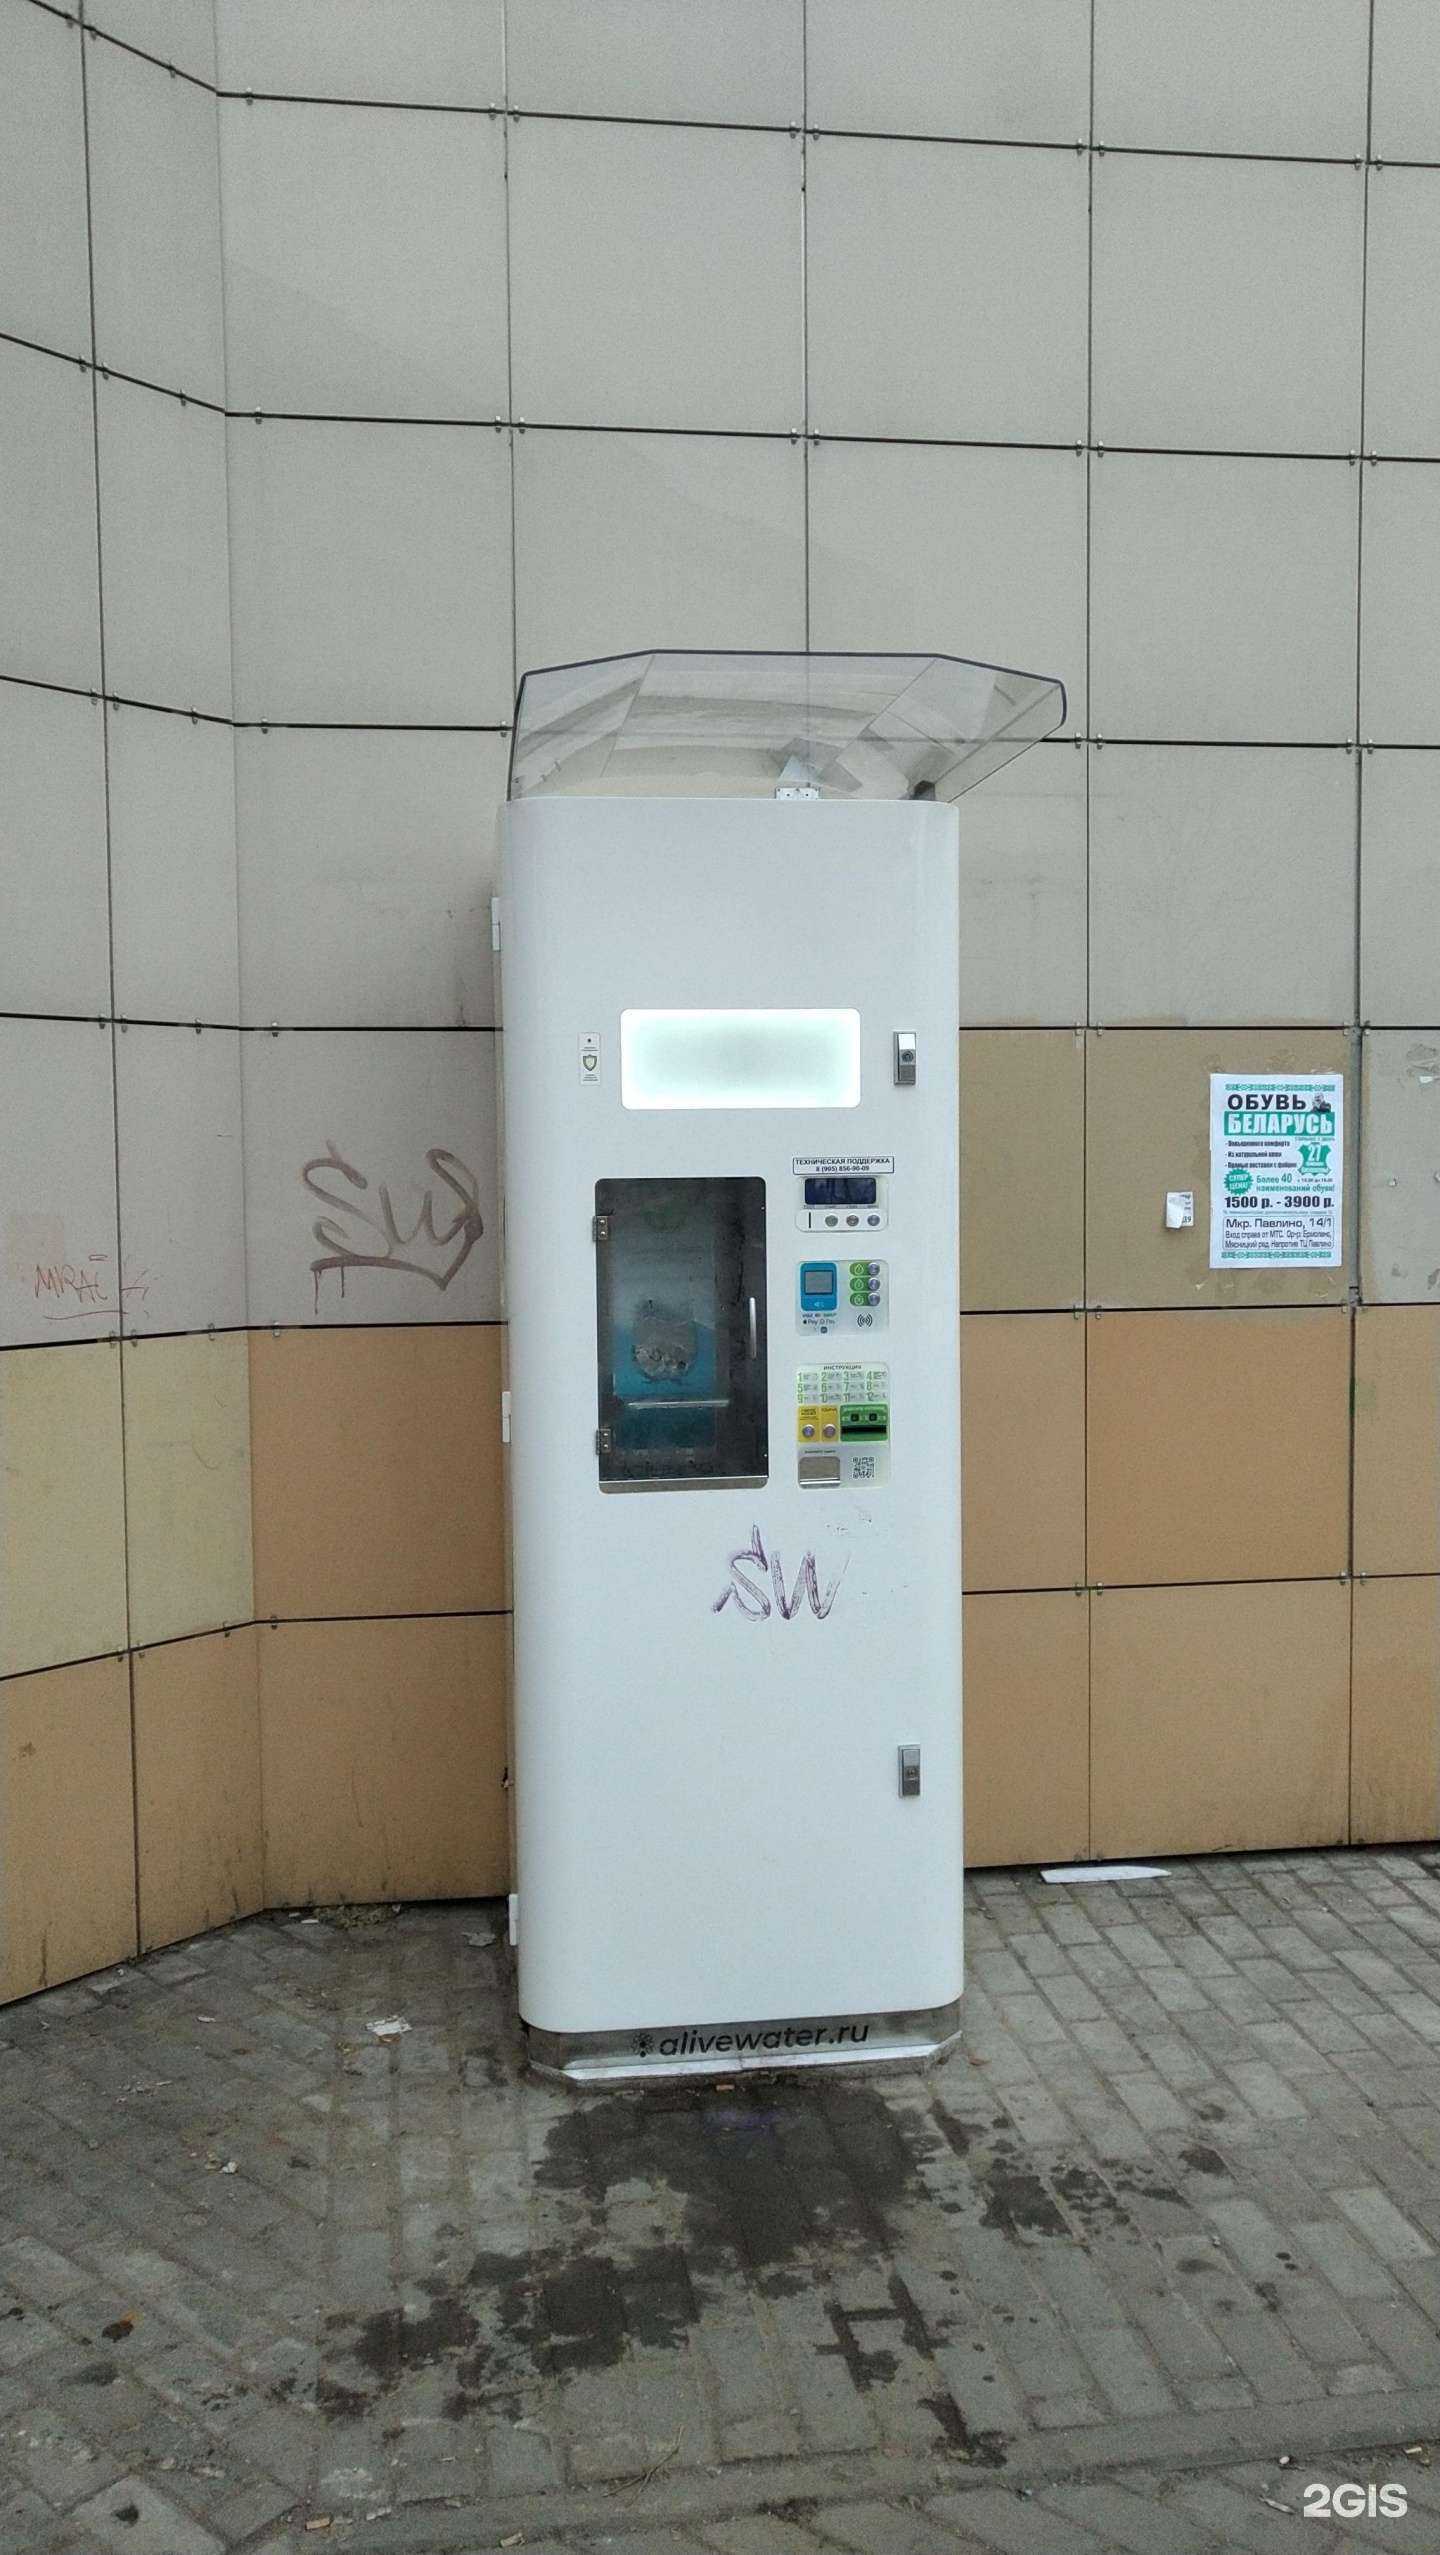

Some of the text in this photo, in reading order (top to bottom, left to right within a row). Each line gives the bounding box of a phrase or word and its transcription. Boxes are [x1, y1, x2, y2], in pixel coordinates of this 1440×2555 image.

[1227, 1094, 1306, 1111] ОБУВЬ
[1227, 1113, 1333, 1135] БЕЛАРУСЬ
[795, 1157, 890, 1166] ТЕХНИЧЕСКАЯ ПОДДЕРЖКА
[1281, 1173, 1292, 1183] 40
[1256, 1183, 1311, 1192] наименований
[1225, 1196, 1258, 1208] 1500
[1284, 1195, 1320, 1208] 3900
[1226, 1217, 1332, 1230] Мкр. Павлино, 14/1
[659, 2022, 870, 2057] alivewater.ru
